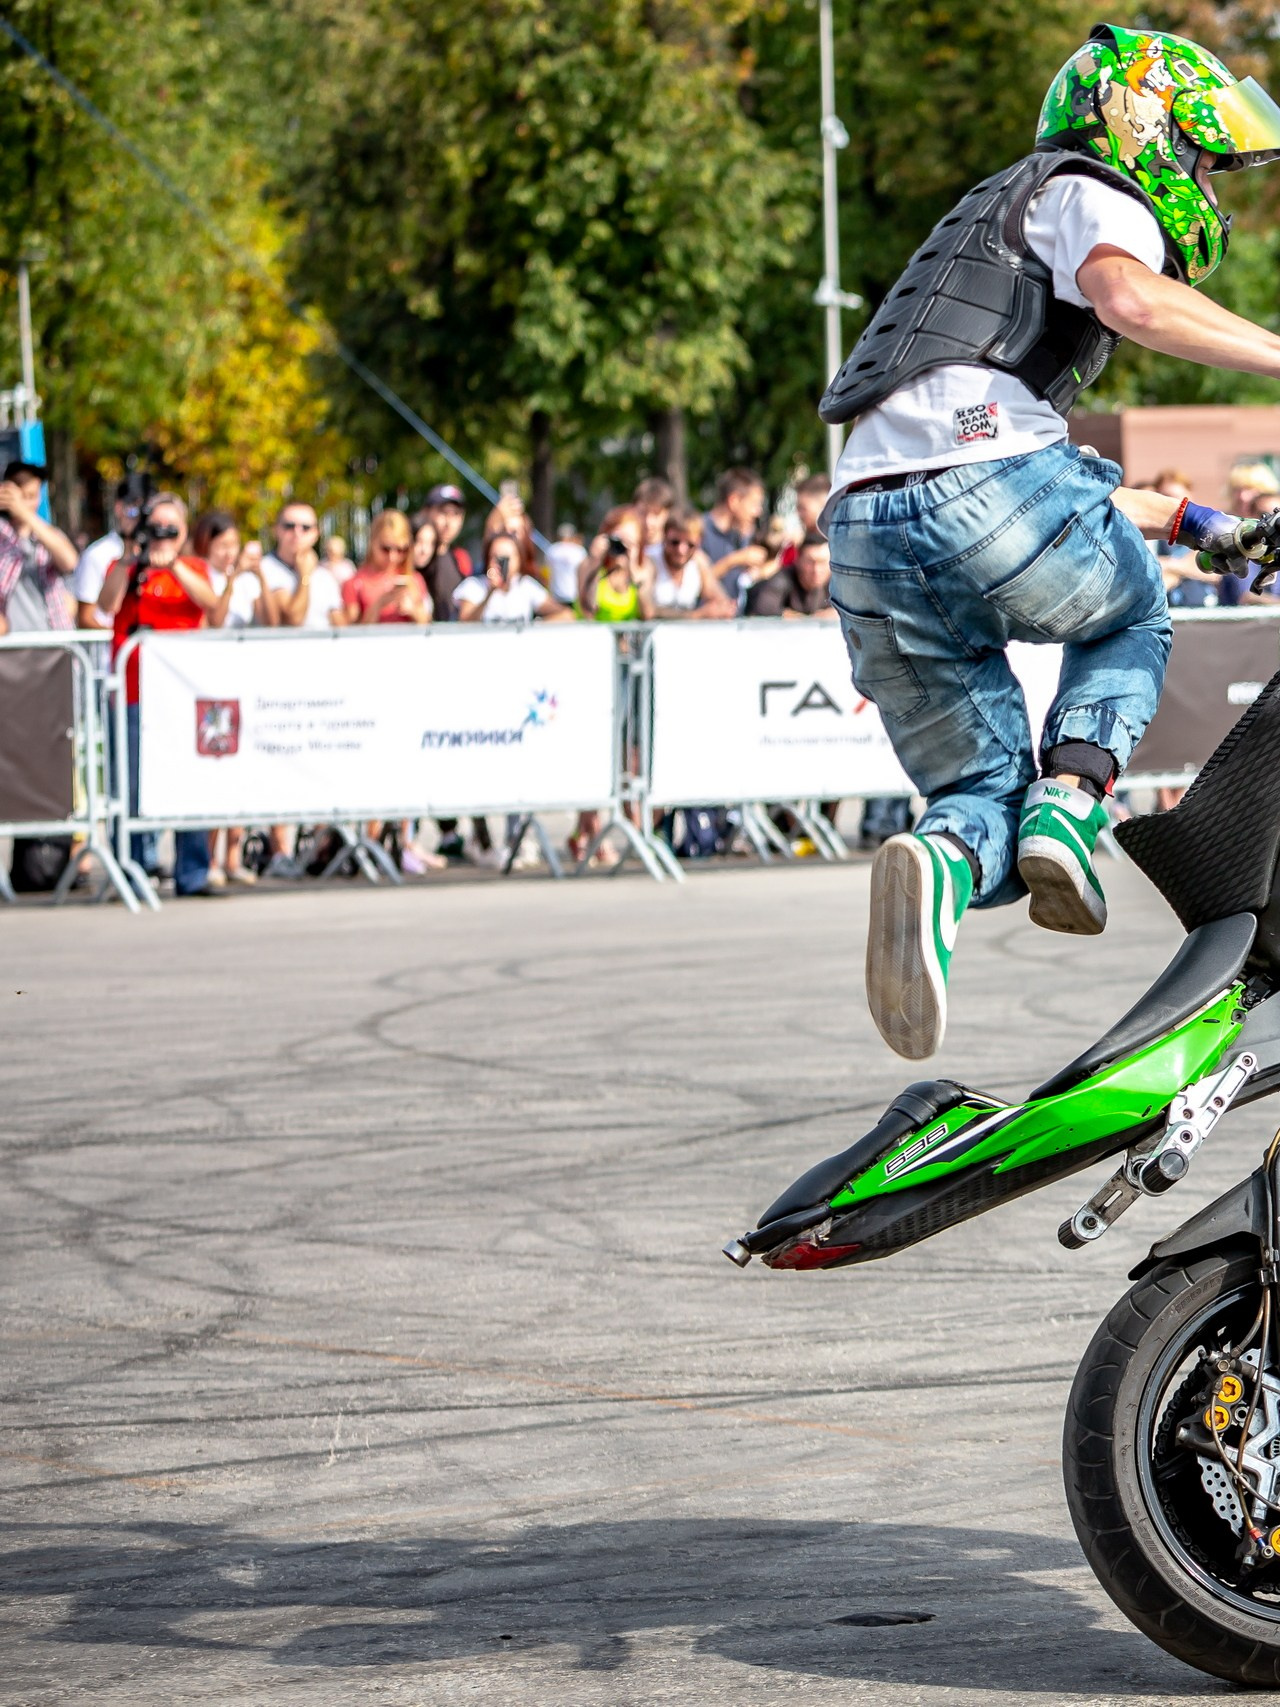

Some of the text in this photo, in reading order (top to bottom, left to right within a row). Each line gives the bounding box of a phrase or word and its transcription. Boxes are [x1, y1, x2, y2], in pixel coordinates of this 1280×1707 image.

[957, 404, 986, 419] RSO
[963, 420, 991, 435] COM
[760, 678, 870, 717] ГА
[1043, 786, 1071, 801] NIKE
[885, 1123, 948, 1176] 636
